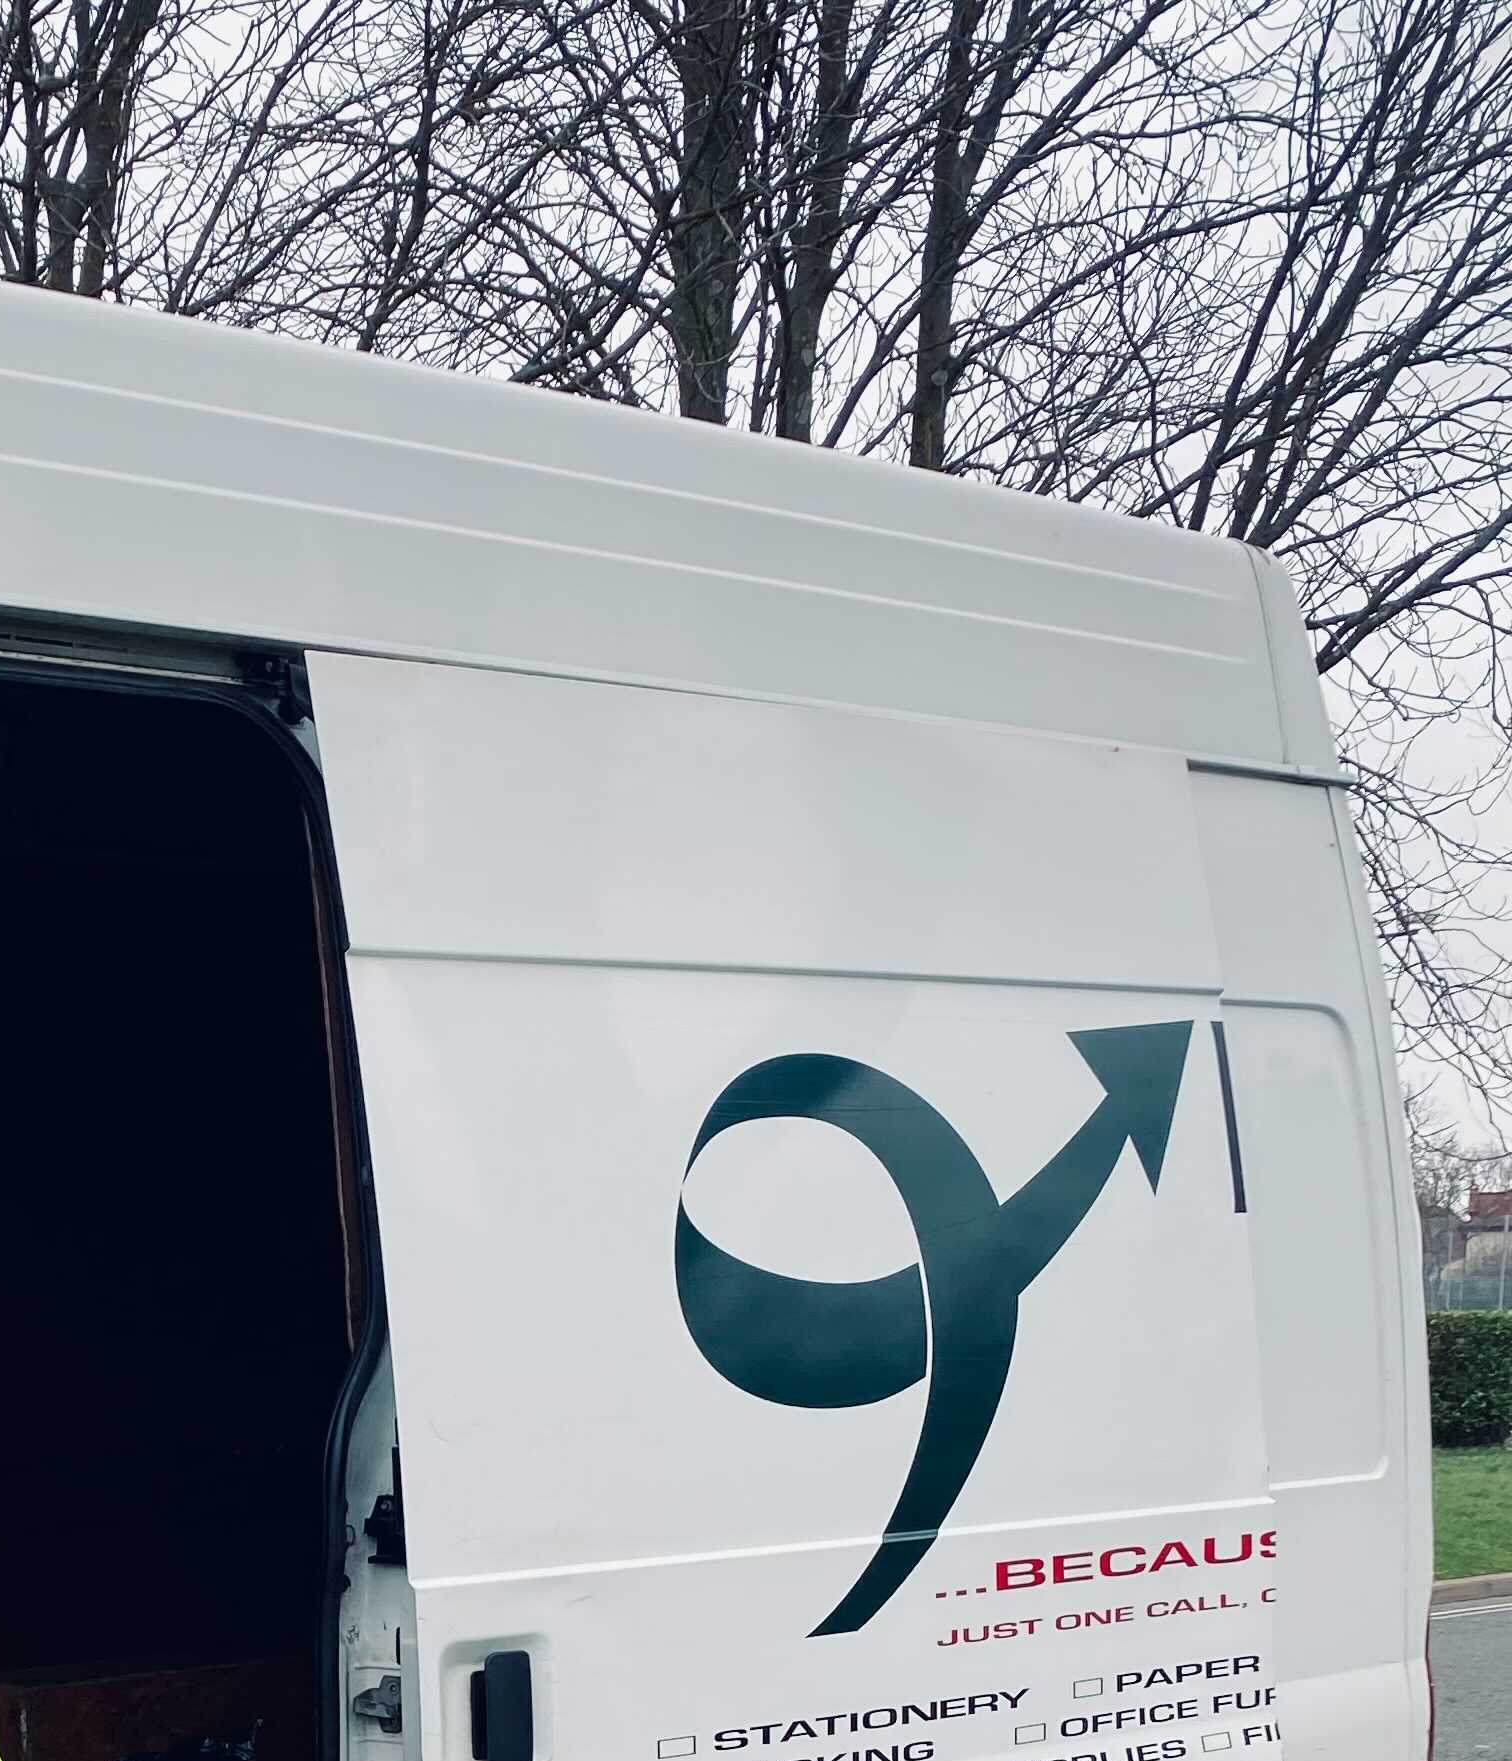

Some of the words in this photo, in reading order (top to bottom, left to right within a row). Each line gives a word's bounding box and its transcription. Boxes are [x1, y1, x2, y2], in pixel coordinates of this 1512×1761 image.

[937, 1619, 1043, 1647] JUST
[1055, 1606, 1135, 1631] ONE
[1146, 1593, 1248, 1618] CALL,
[1116, 1655, 1260, 1693] PAPER
[713, 1688, 1031, 1752] STATIONERY
[1060, 1699, 1199, 1738] OFFICE
[1242, 1722, 1281, 1746] FI
